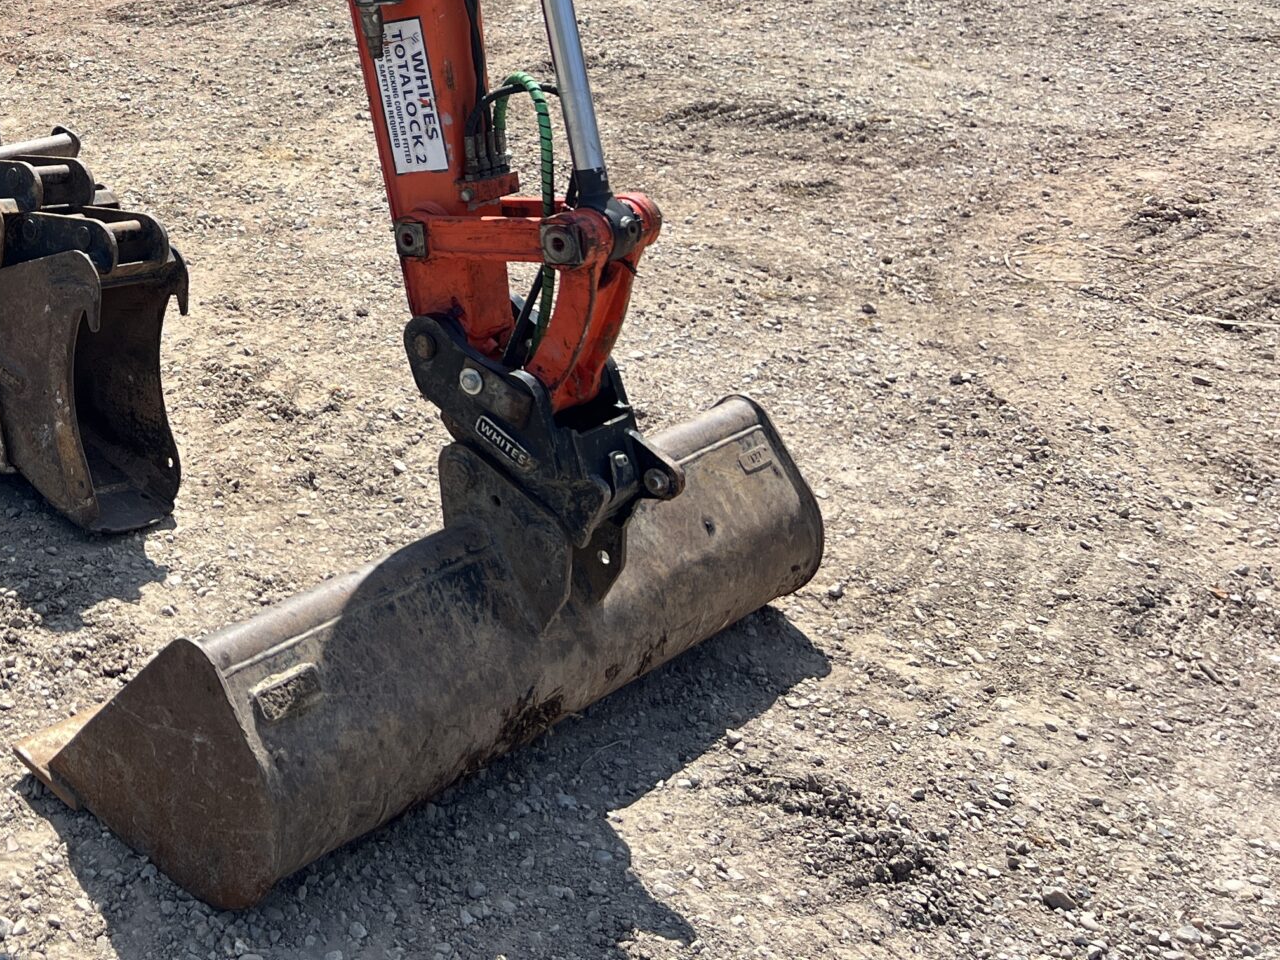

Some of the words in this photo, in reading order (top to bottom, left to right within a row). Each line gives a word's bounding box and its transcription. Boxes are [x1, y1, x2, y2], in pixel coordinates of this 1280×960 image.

[378, 64, 389, 93] SAFETY
[391, 29, 425, 151] TOTALOCK
[415, 154, 427, 165] 2
[411, 50, 439, 141] WHITES
[384, 94, 393, 109] PIN
[387, 65, 399, 99] LOCKING
[394, 100, 407, 136] COUPLER
[401, 137, 412, 164] FITTED
[388, 110, 401, 149] REQUIRED
[481, 421, 526, 465] WHITES
